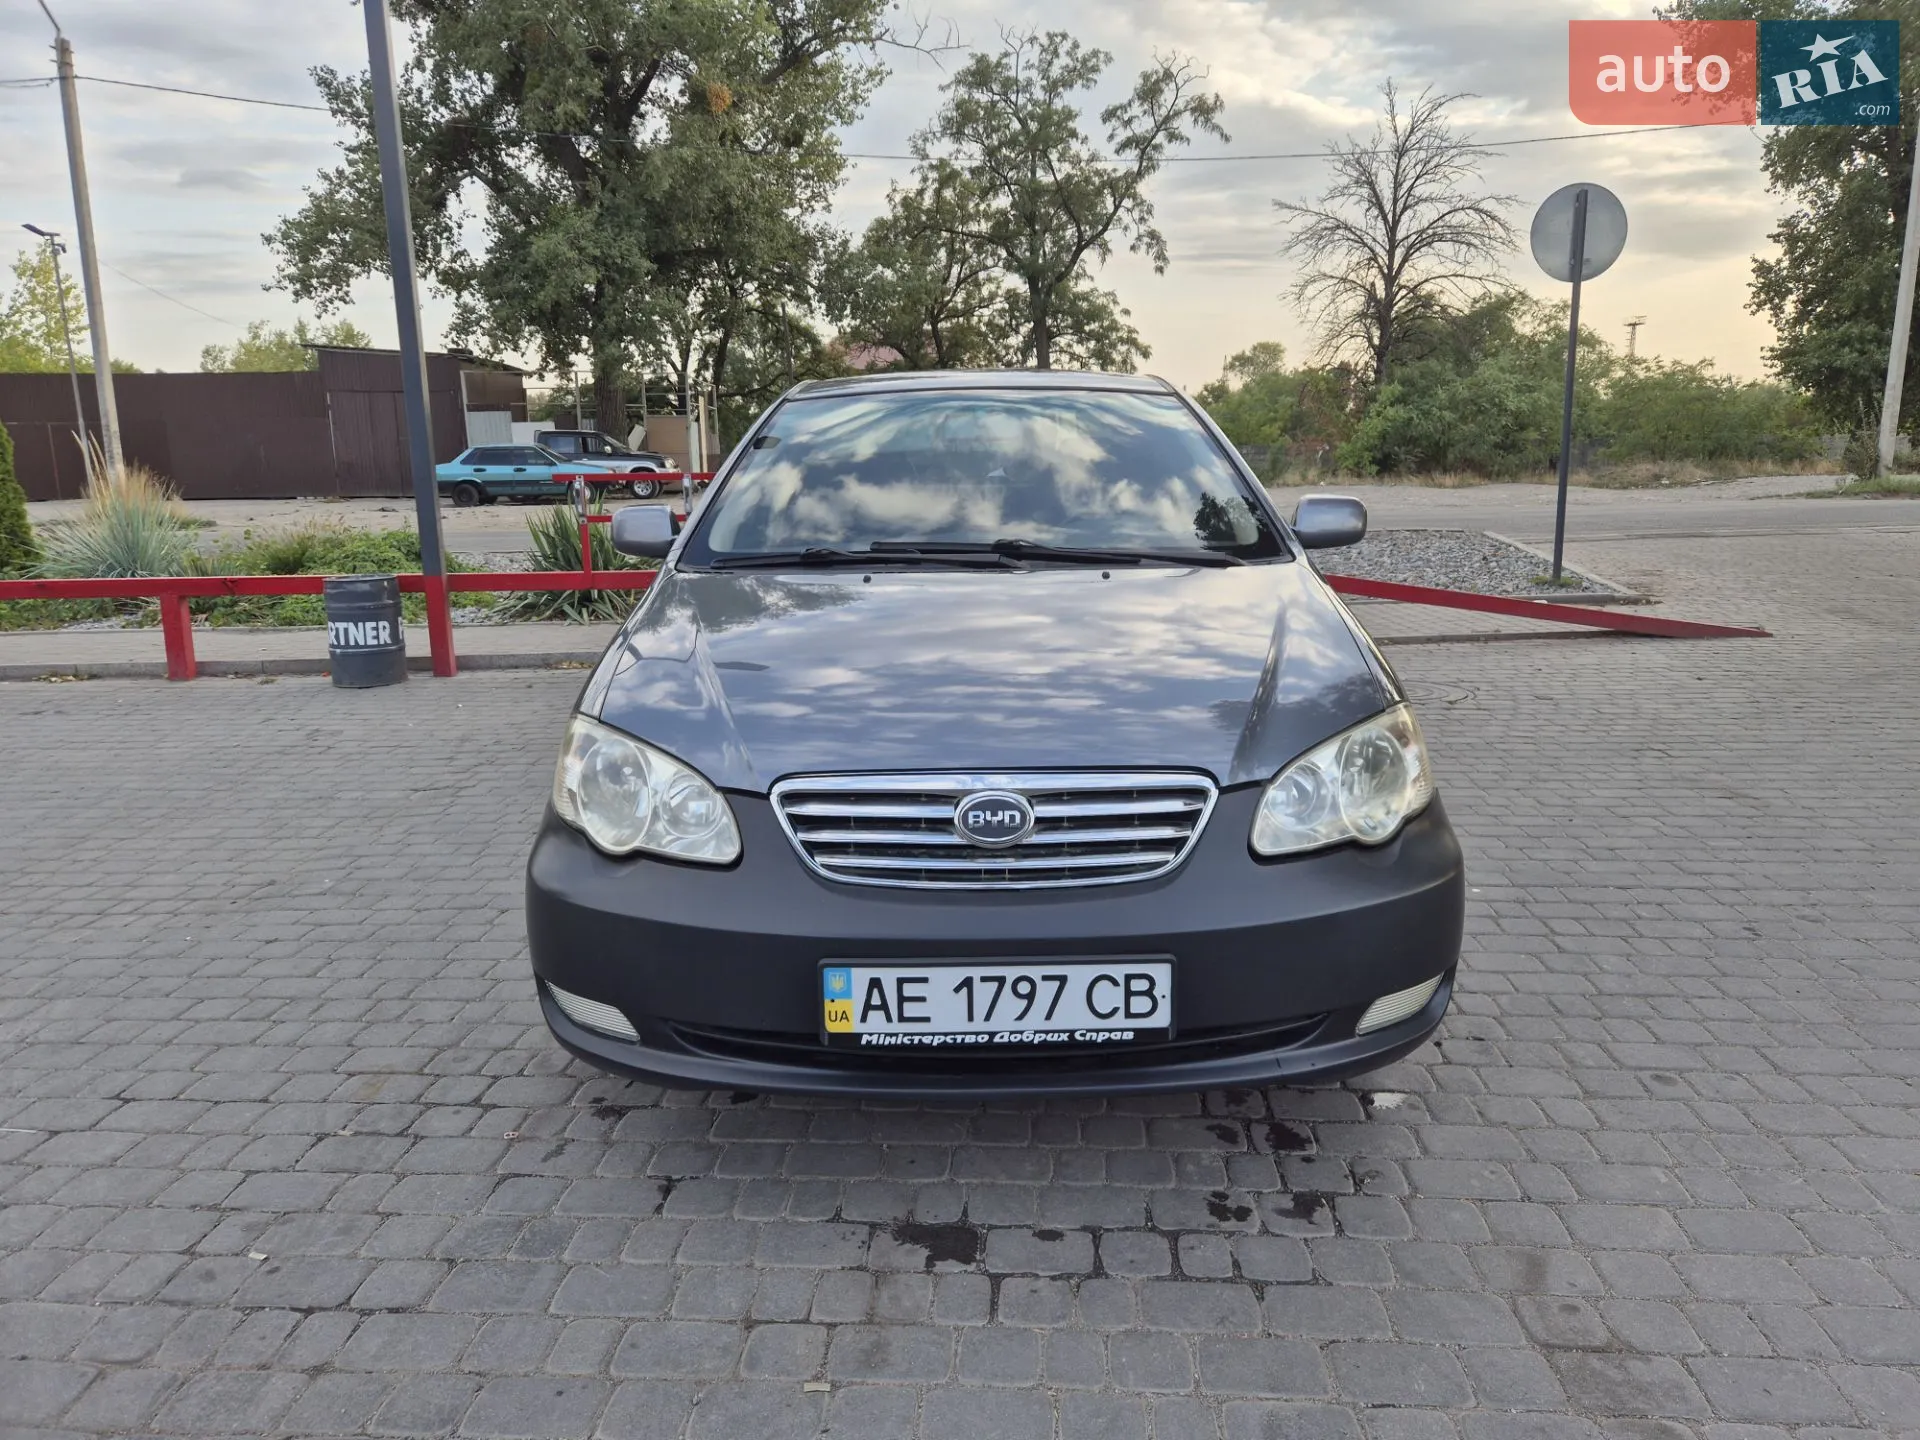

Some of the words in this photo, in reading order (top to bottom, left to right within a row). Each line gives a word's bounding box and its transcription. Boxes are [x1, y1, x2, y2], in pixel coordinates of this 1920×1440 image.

[968, 810, 1021, 828] BYD
[860, 976, 932, 1024] AE
[952, 974, 1068, 1023] 1797
[1085, 973, 1159, 1020] CB
[828, 1010, 850, 1023] UA
[860, 1030, 990, 1046] Міністерство
[993, 1029, 1070, 1044] Добрих
[1073, 1029, 1135, 1043] Справ
